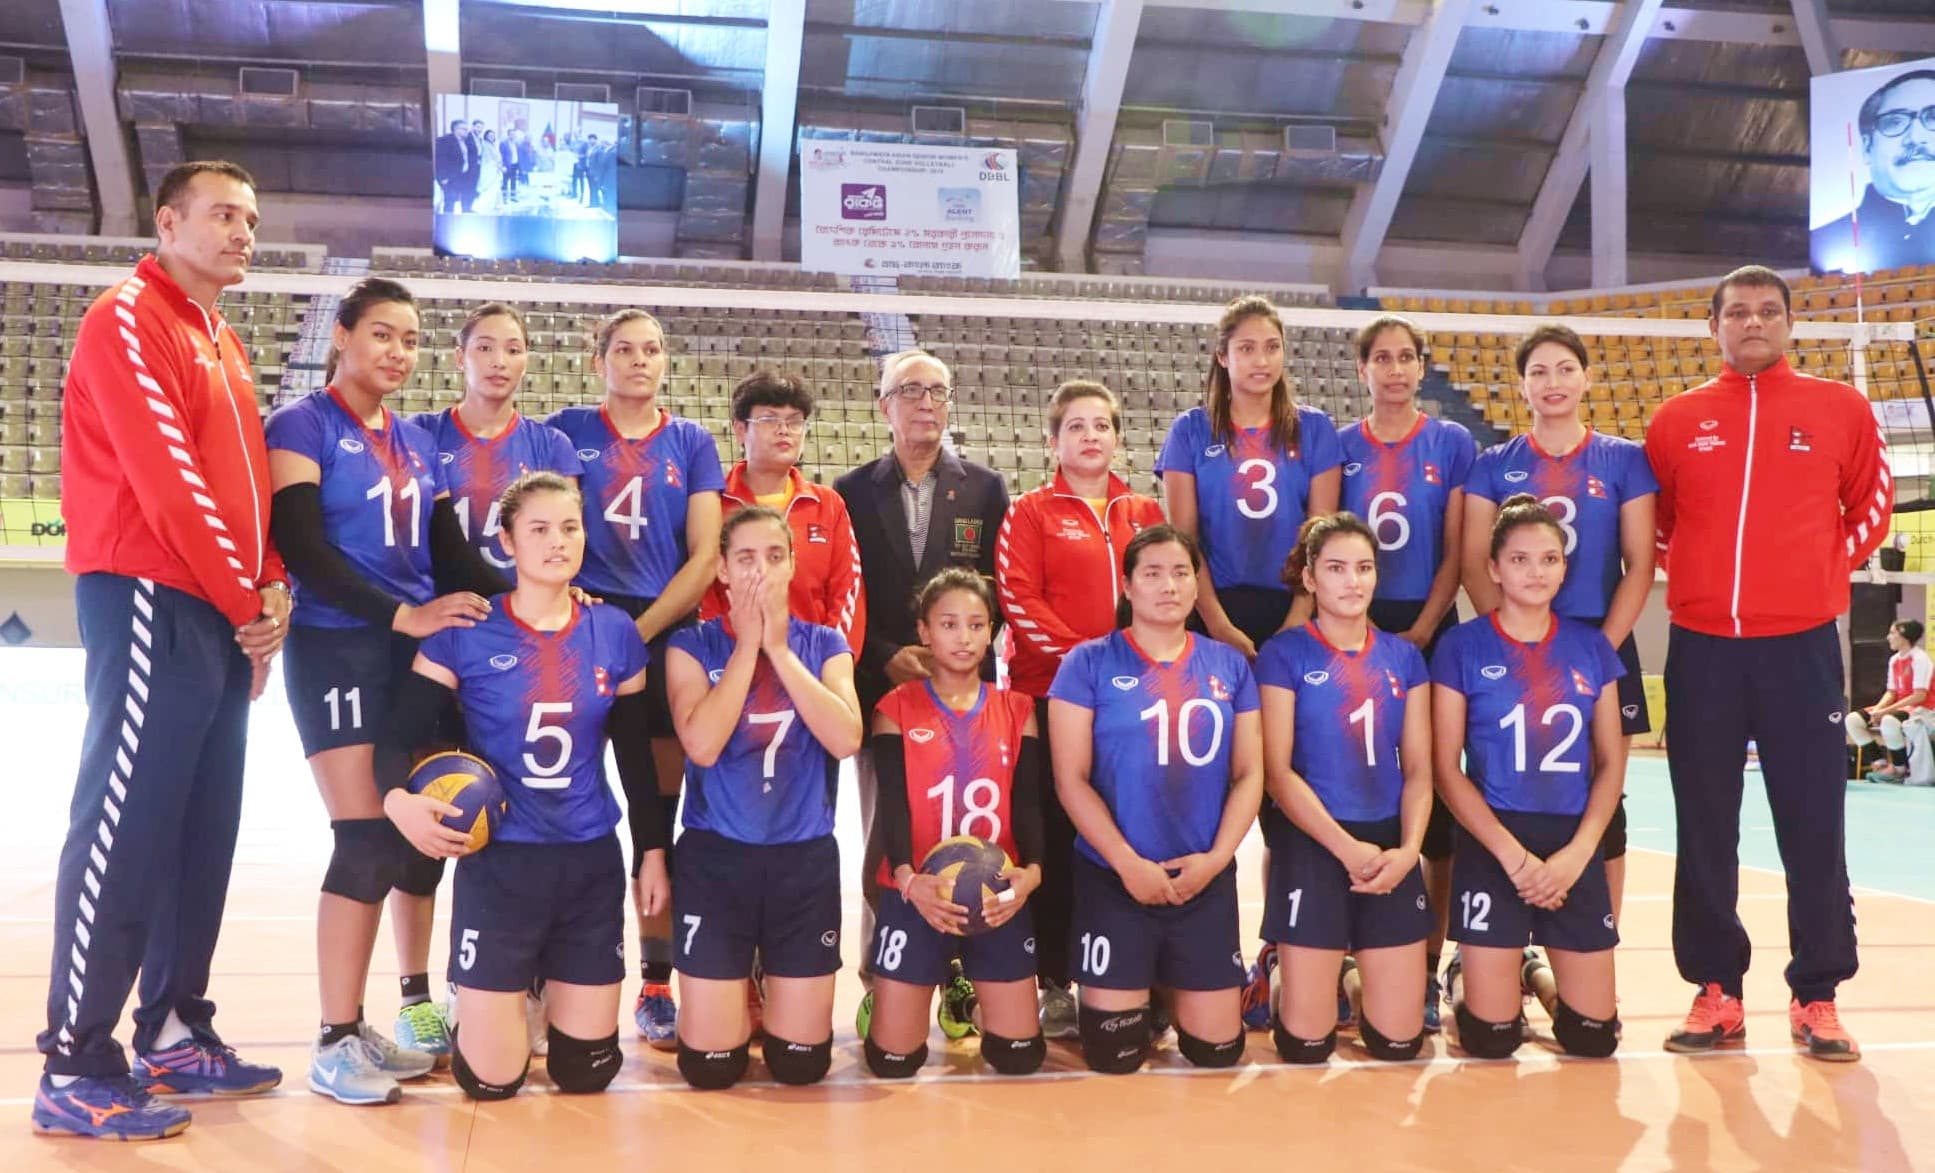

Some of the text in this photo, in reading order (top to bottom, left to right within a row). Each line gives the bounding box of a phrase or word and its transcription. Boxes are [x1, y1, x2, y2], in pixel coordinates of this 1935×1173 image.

[366, 475, 421, 547] 11
[604, 476, 648, 540] 4
[1236, 458, 1278, 519] 3
[1368, 491, 1410, 551] 6
[324, 687, 362, 730] 11
[1140, 698, 1224, 767] 10
[1349, 698, 1376, 766] 1
[1499, 703, 1583, 772] 12
[522, 702, 573, 777] 5
[748, 709, 795, 778] 7
[927, 775, 1001, 844] 18
[683, 914, 701, 955] 7
[1288, 888, 1302, 927] 1
[1462, 891, 1491, 931] 12
[459, 928, 480, 971] 5
[876, 926, 907, 971] 18
[1081, 933, 1110, 976] 10
